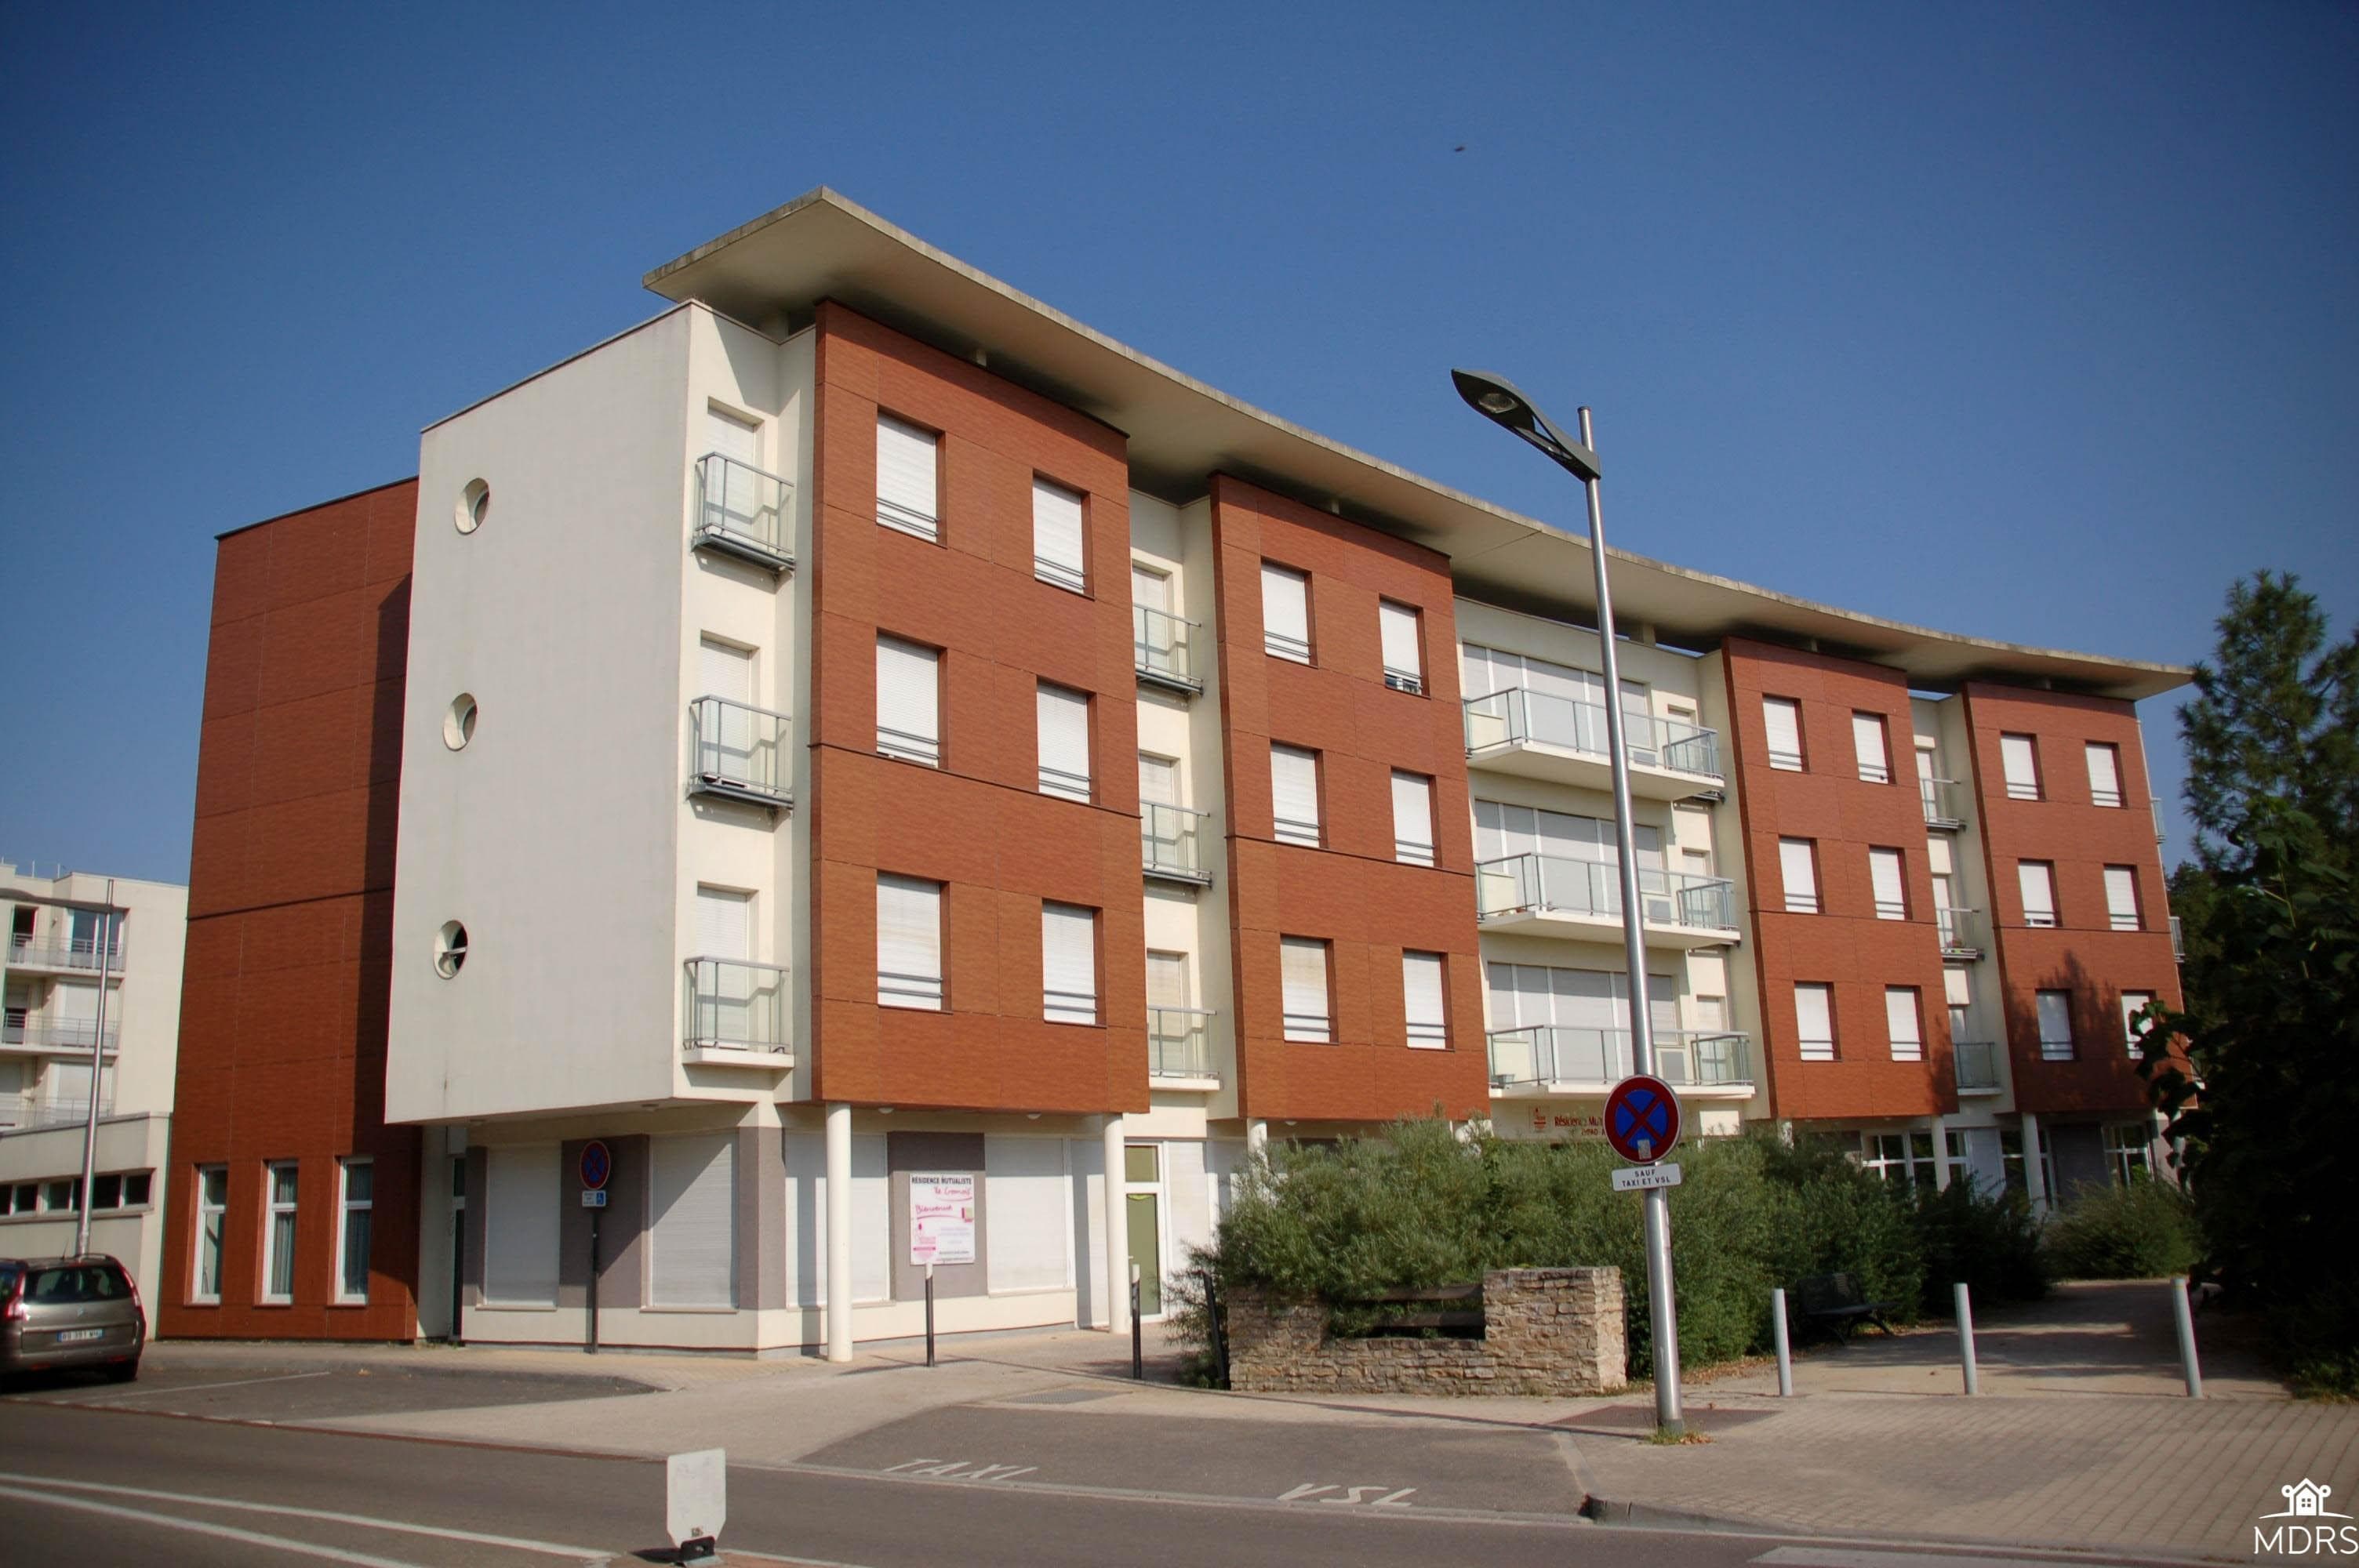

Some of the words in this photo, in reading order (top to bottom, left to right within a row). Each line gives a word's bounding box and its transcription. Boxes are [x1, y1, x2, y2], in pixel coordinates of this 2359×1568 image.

[1634, 1169, 1656, 1178] SAUF
[881, 1457, 1039, 1481] TAXI
[1276, 1483, 1418, 1507] VSL
